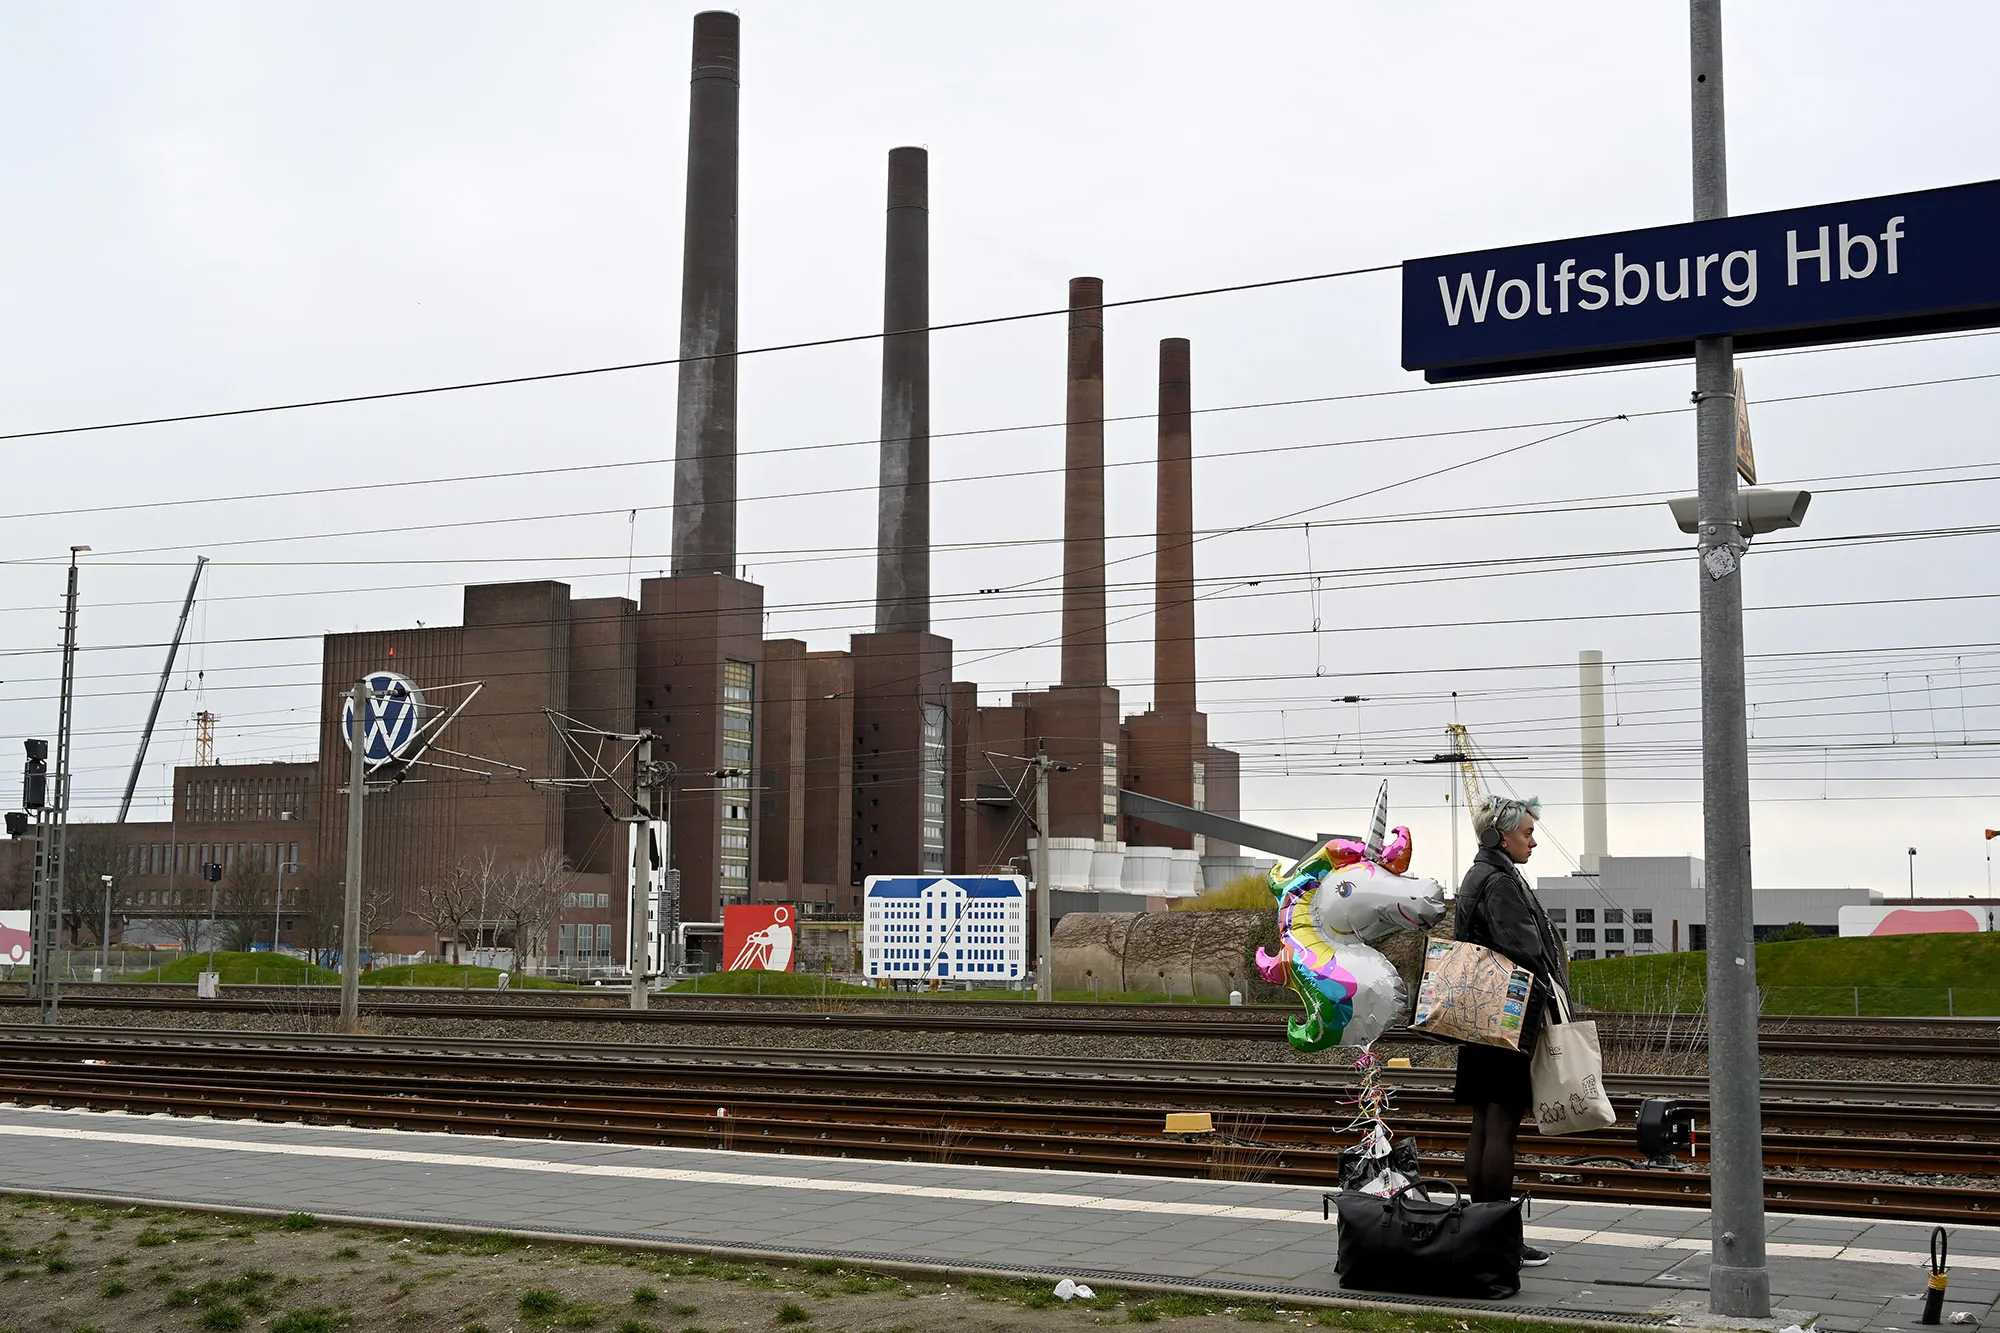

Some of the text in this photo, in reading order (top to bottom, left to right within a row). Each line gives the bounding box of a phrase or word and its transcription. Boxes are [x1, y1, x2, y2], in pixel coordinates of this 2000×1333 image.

[1437, 215, 1905, 327] Wolfsburg Hbf
[346, 675, 413, 757] VW
